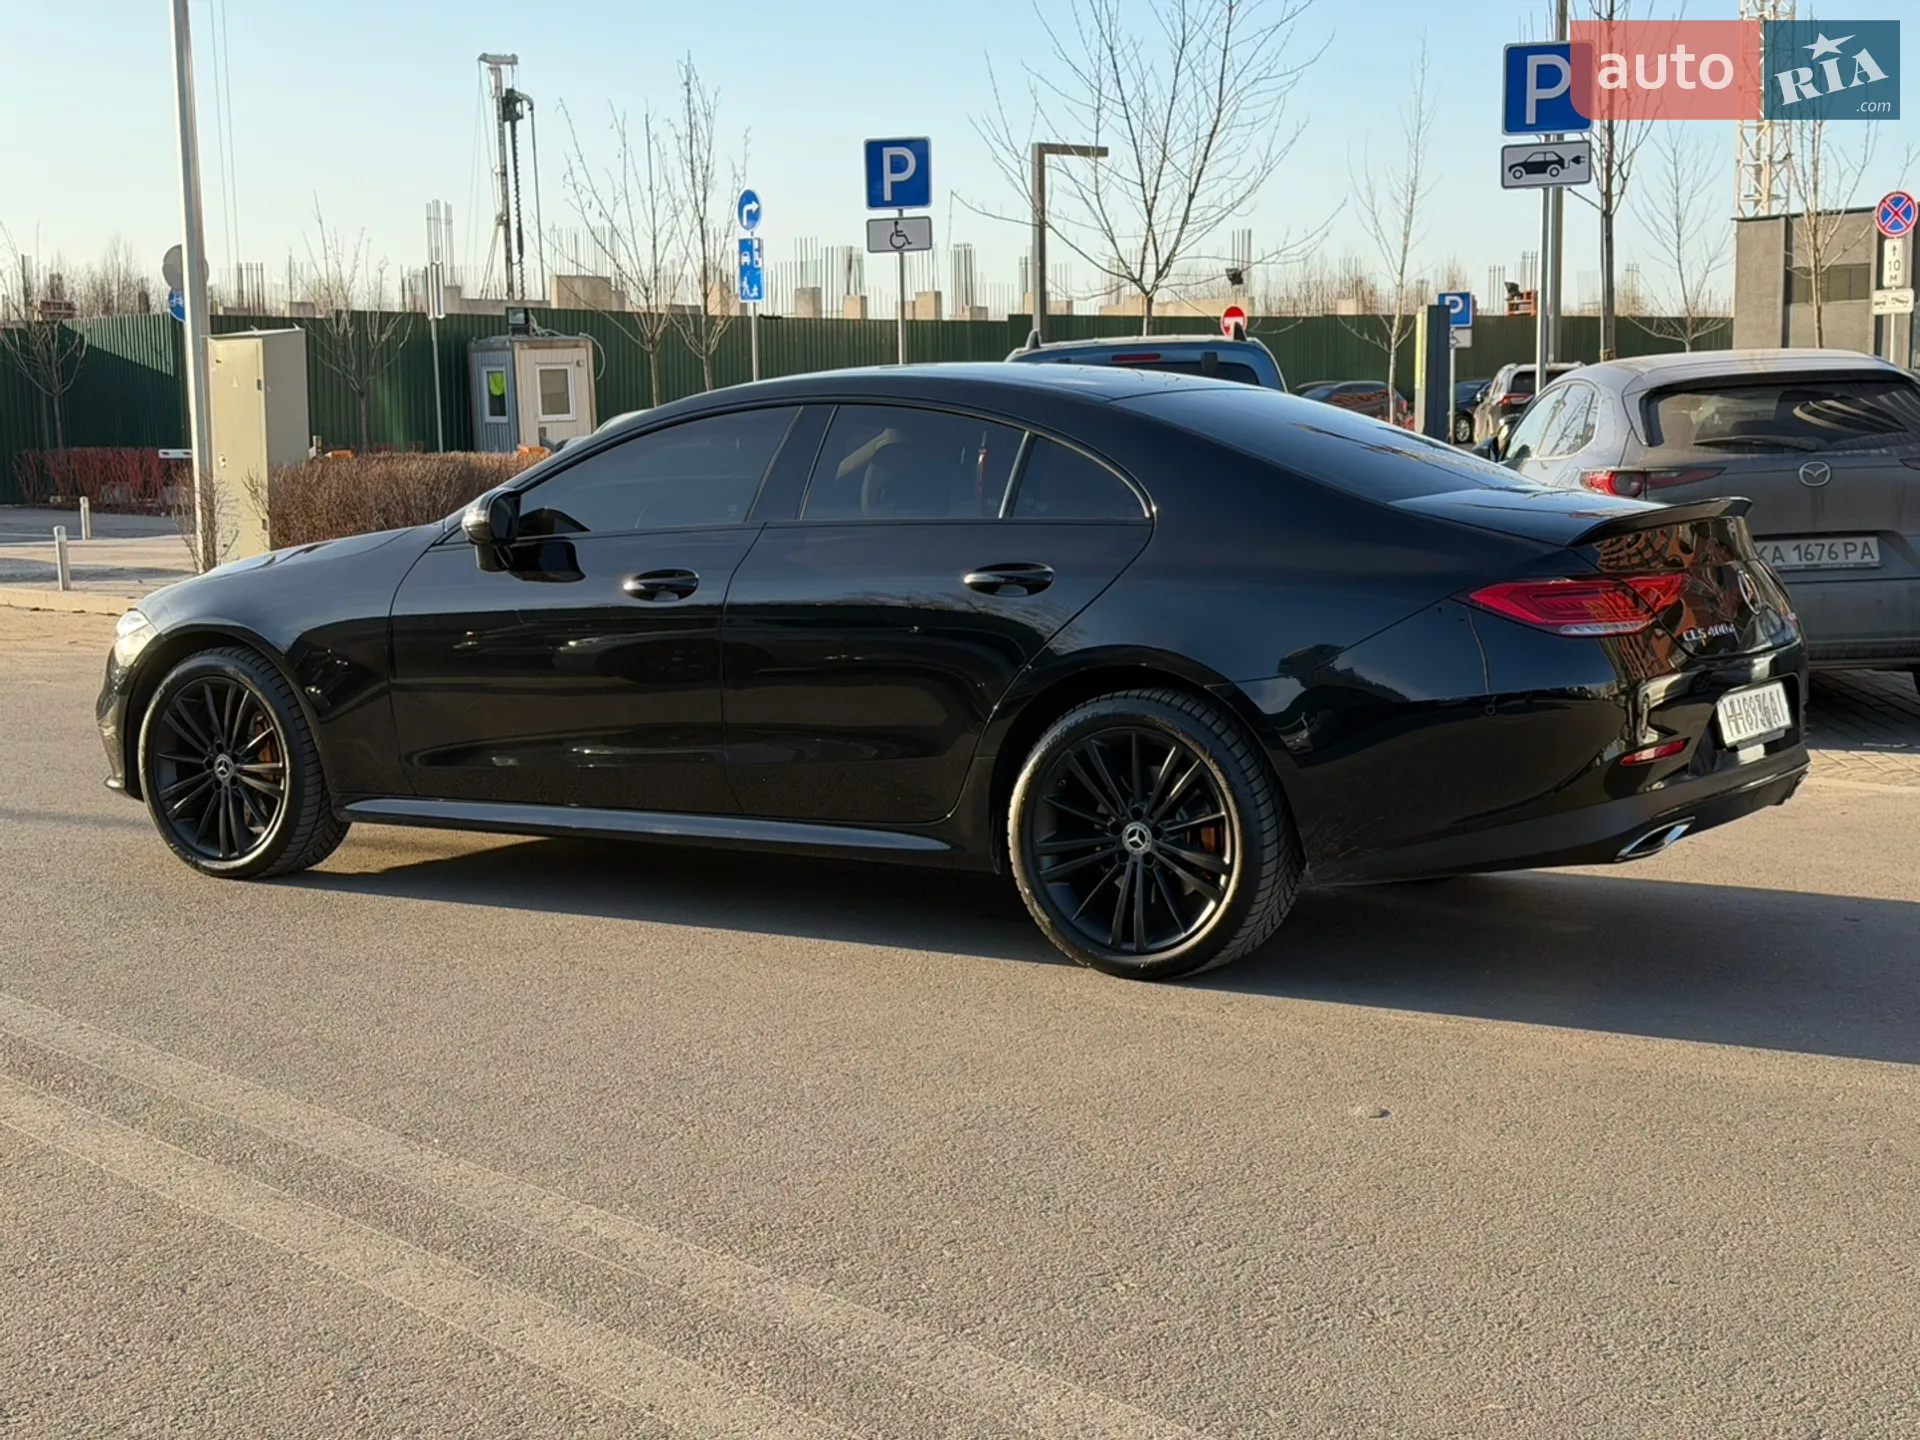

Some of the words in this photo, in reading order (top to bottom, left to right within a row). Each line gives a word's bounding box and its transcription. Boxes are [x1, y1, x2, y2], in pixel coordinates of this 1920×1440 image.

[1526, 54, 1572, 125] P
[882, 146, 916, 202] P
[1887, 259, 1901, 272] 10
[1792, 542, 1839, 562] 1676
[1843, 541, 1875, 560] PA
